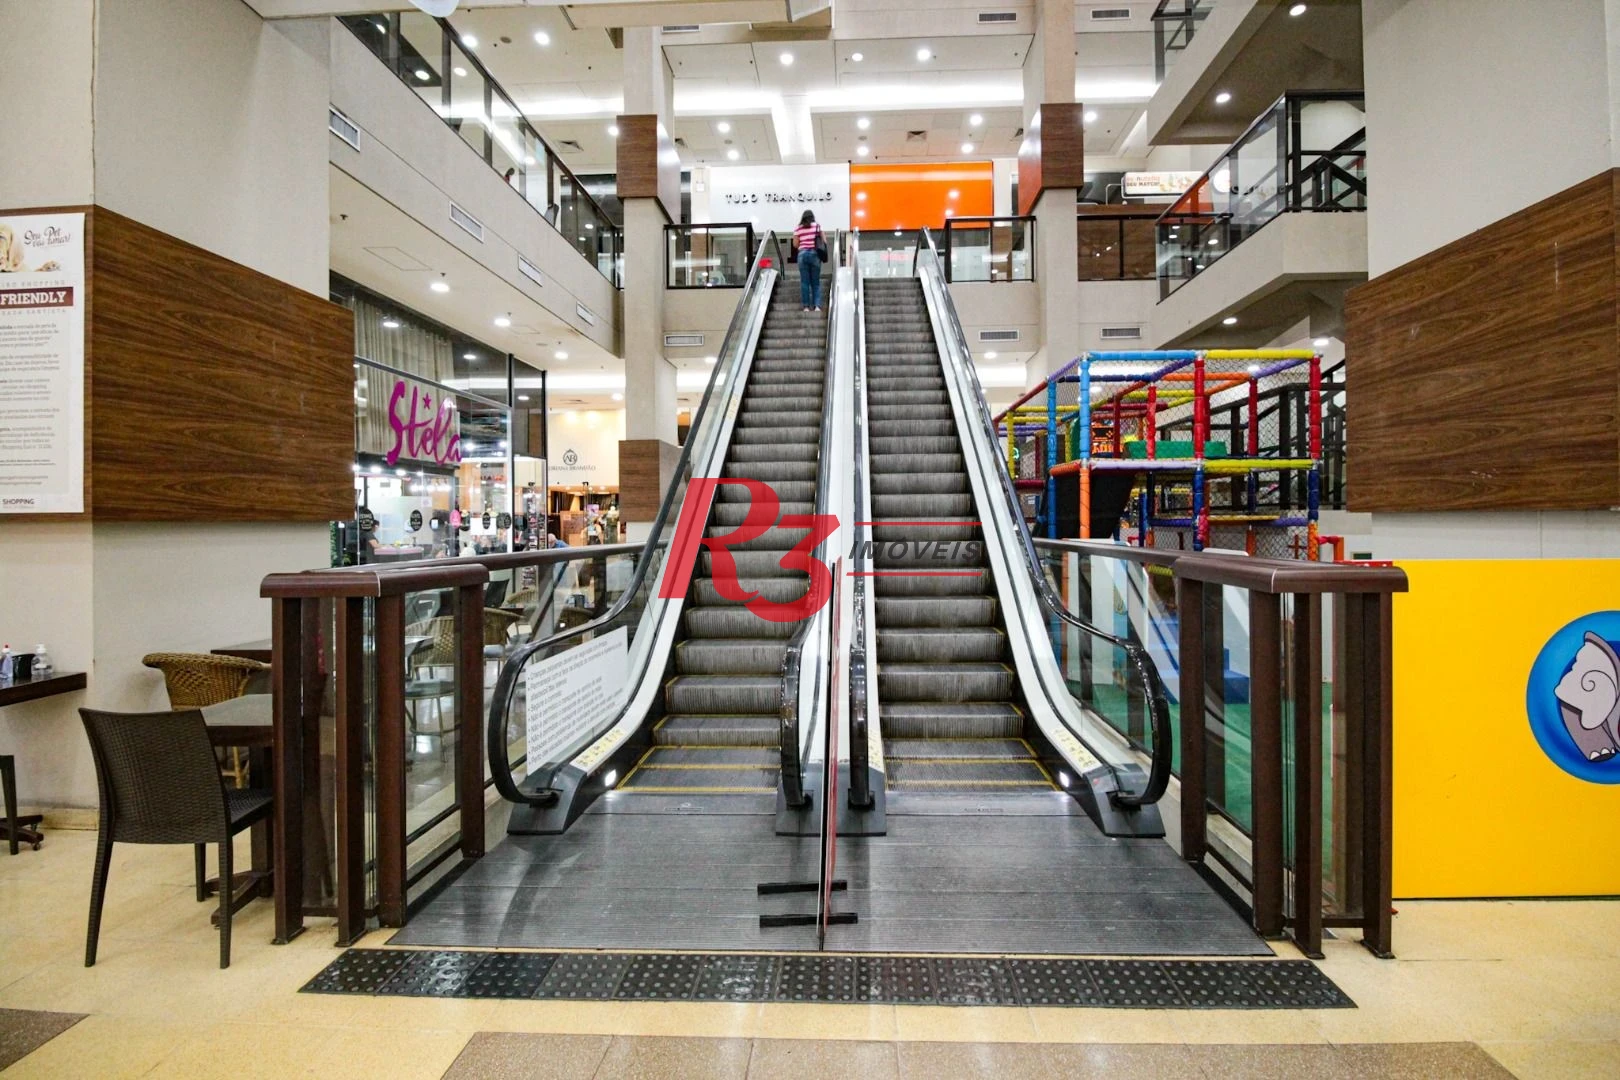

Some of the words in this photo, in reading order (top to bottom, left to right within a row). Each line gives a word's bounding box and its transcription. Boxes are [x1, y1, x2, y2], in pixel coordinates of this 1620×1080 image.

[725, 193, 758, 204] TUDO
[764, 192, 832, 203] TRANQUILO
[0, 291, 67, 305] FRIENDLY
